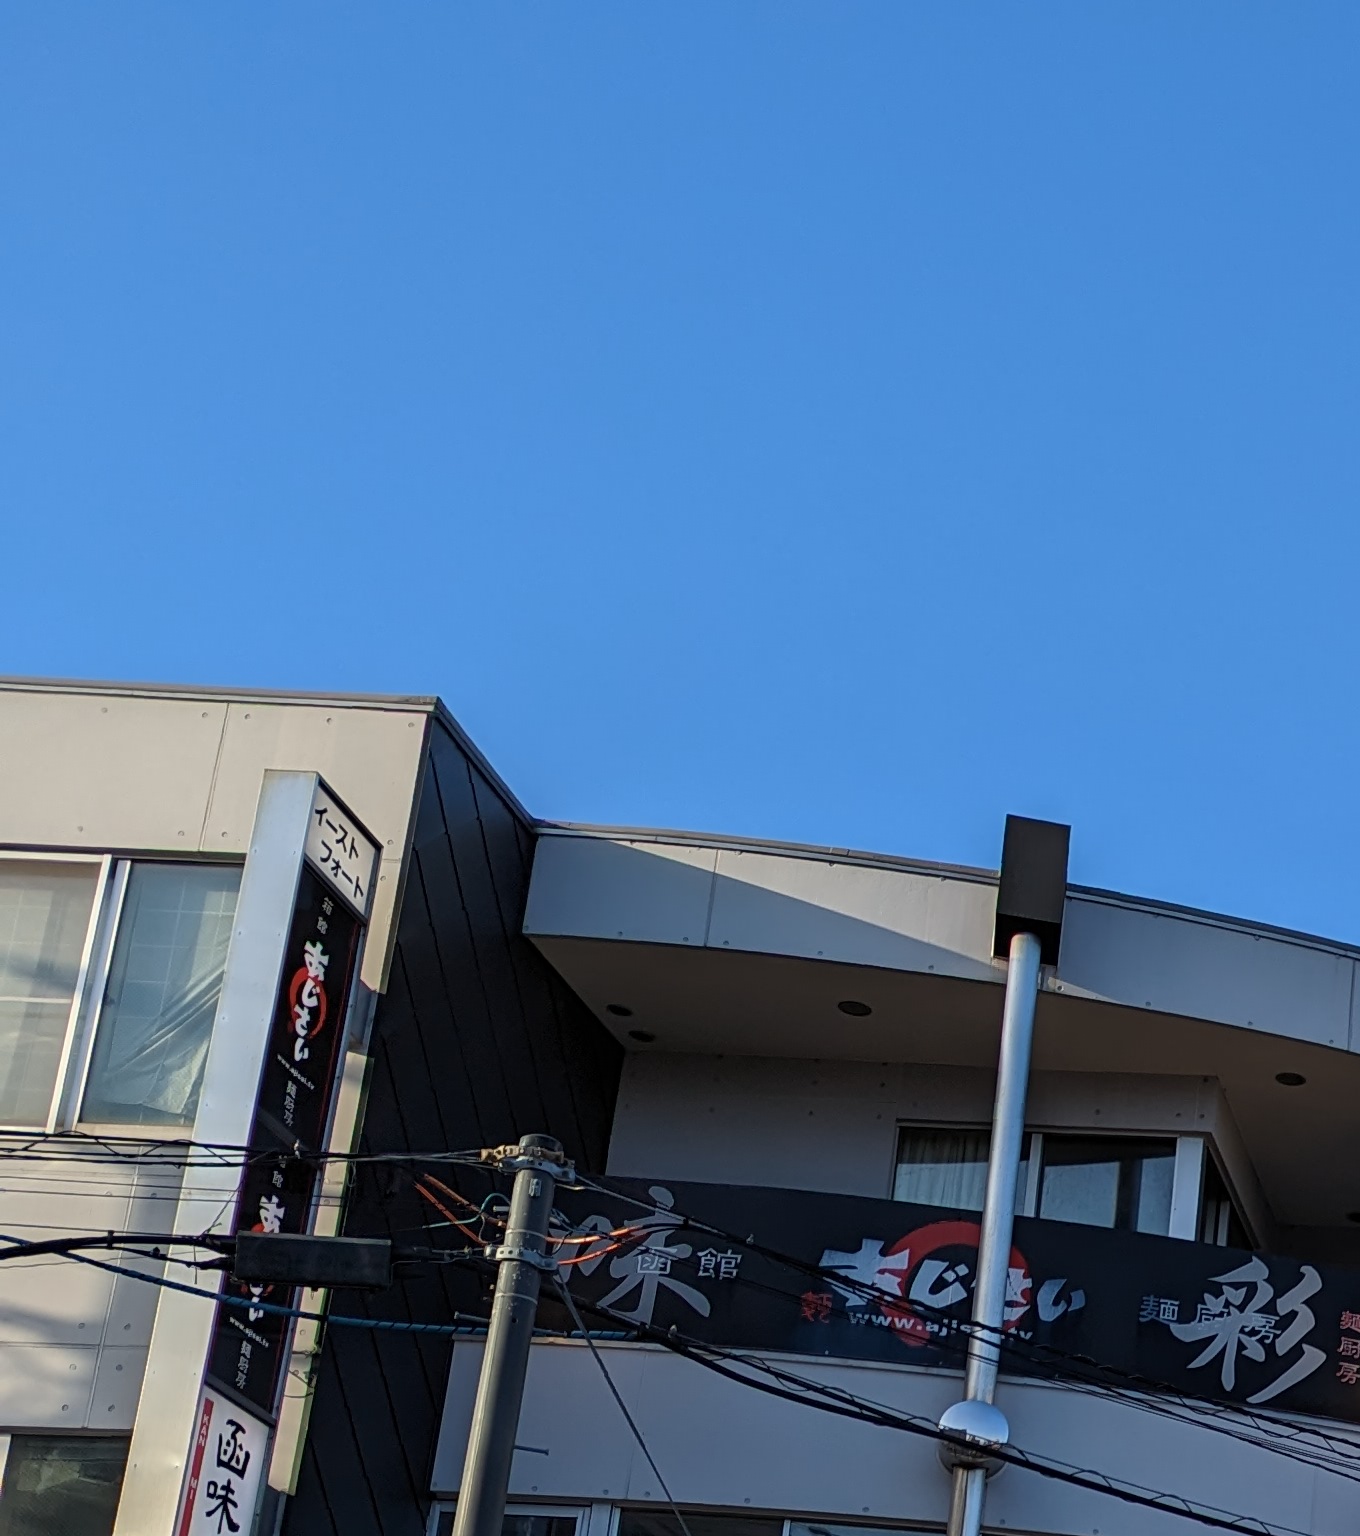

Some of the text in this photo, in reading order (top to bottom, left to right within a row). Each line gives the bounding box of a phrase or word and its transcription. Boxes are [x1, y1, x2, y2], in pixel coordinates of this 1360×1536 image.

[314, 805, 360, 861] イースト
[319, 840, 364, 900] フォート
[293, 940, 330, 1062] あじさい
[636, 1247, 742, 1281] 函館
[848, 1311, 1034, 1341] www.ajis.tv
[1138, 1294, 1283, 1345] 麺厨房
[1170, 1255, 1328, 1404] 彩
